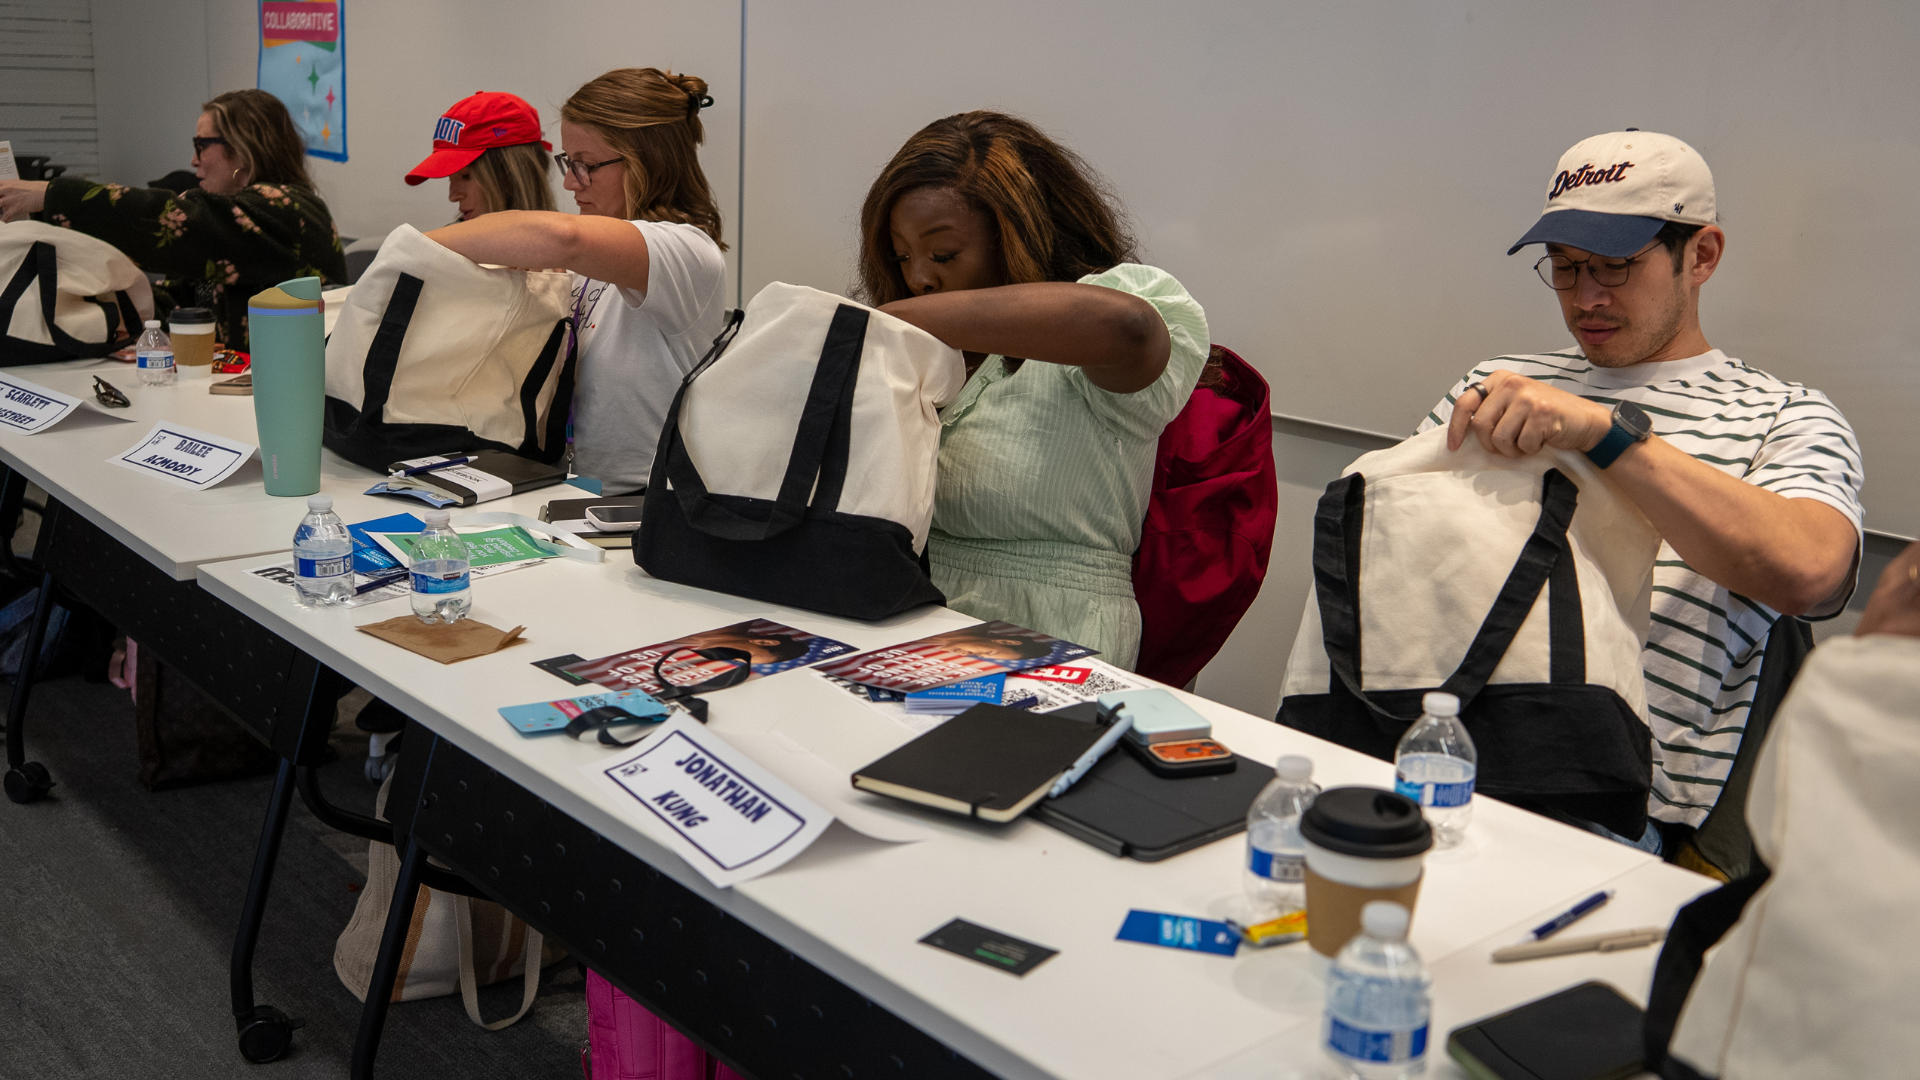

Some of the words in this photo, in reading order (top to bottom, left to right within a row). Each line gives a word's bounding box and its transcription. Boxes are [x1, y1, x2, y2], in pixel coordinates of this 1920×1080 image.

[264, 11, 334, 31] COLLABORATIVE
[549, 161, 635, 201] Detroit
[5, 389, 51, 410] SCARLETT
[174, 439, 214, 458] BAILEE
[142, 454, 202, 476] ACMOODY
[858, 664, 886, 674] OF
[872, 657, 945, 678] MEANS
[884, 653, 925, 665] ALL
[608, 666, 637, 677] OF
[890, 661, 963, 682] PEOPLE
[910, 674, 954, 686] THE
[675, 752, 772, 823] JONATHAN
[652, 790, 709, 828] KUNG
